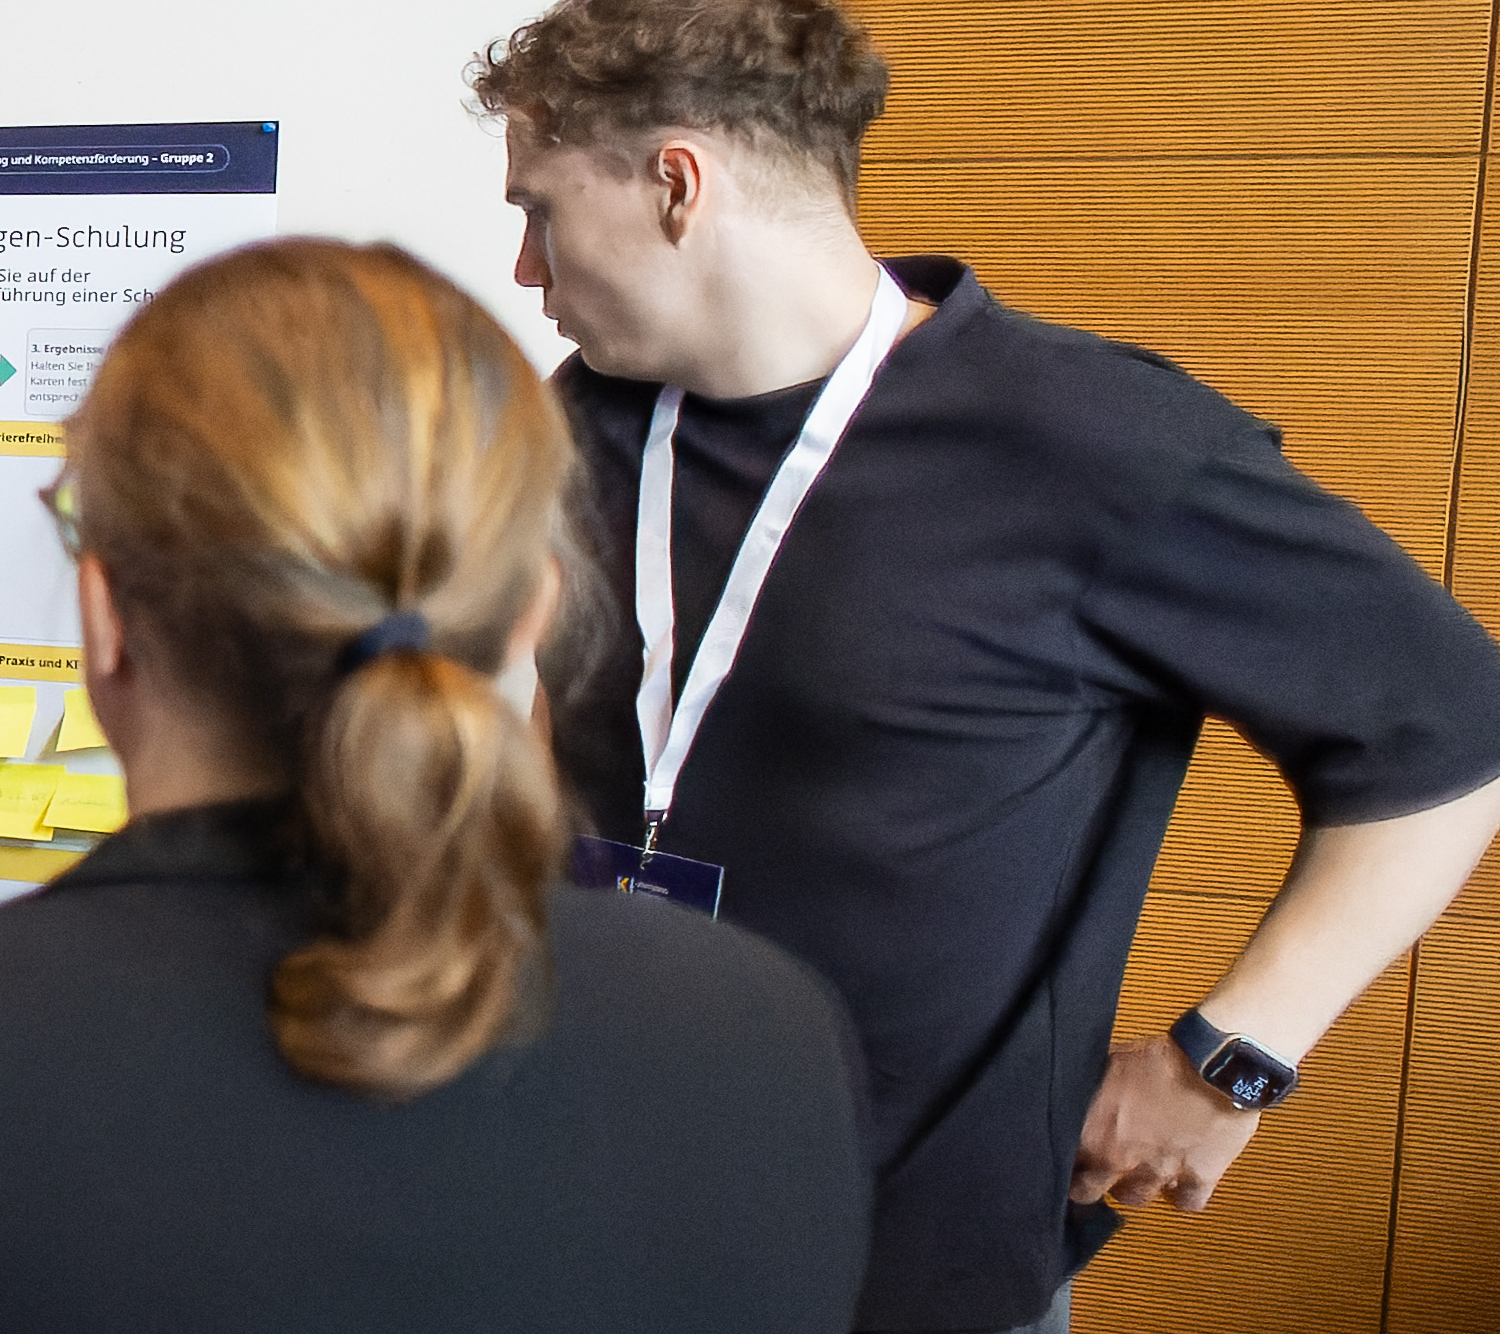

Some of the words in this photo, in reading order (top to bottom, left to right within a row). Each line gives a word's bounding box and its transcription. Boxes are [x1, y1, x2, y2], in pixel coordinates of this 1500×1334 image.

[11, 154, 32, 165] und
[35, 153, 148, 166] Kompetenzförderung
[160, 153, 203, 166] Gruppe
[206, 153, 214, 163] 2
[28, 268, 57, 283] auf
[62, 269, 91, 283] der
[72, 290, 116, 303] einer
[122, 288, 158, 303] Sch
[31, 361, 65, 372] Halten
[68, 361, 83, 372] Sie
[31, 377, 65, 386] Karten
[39, 660, 62, 668] und
